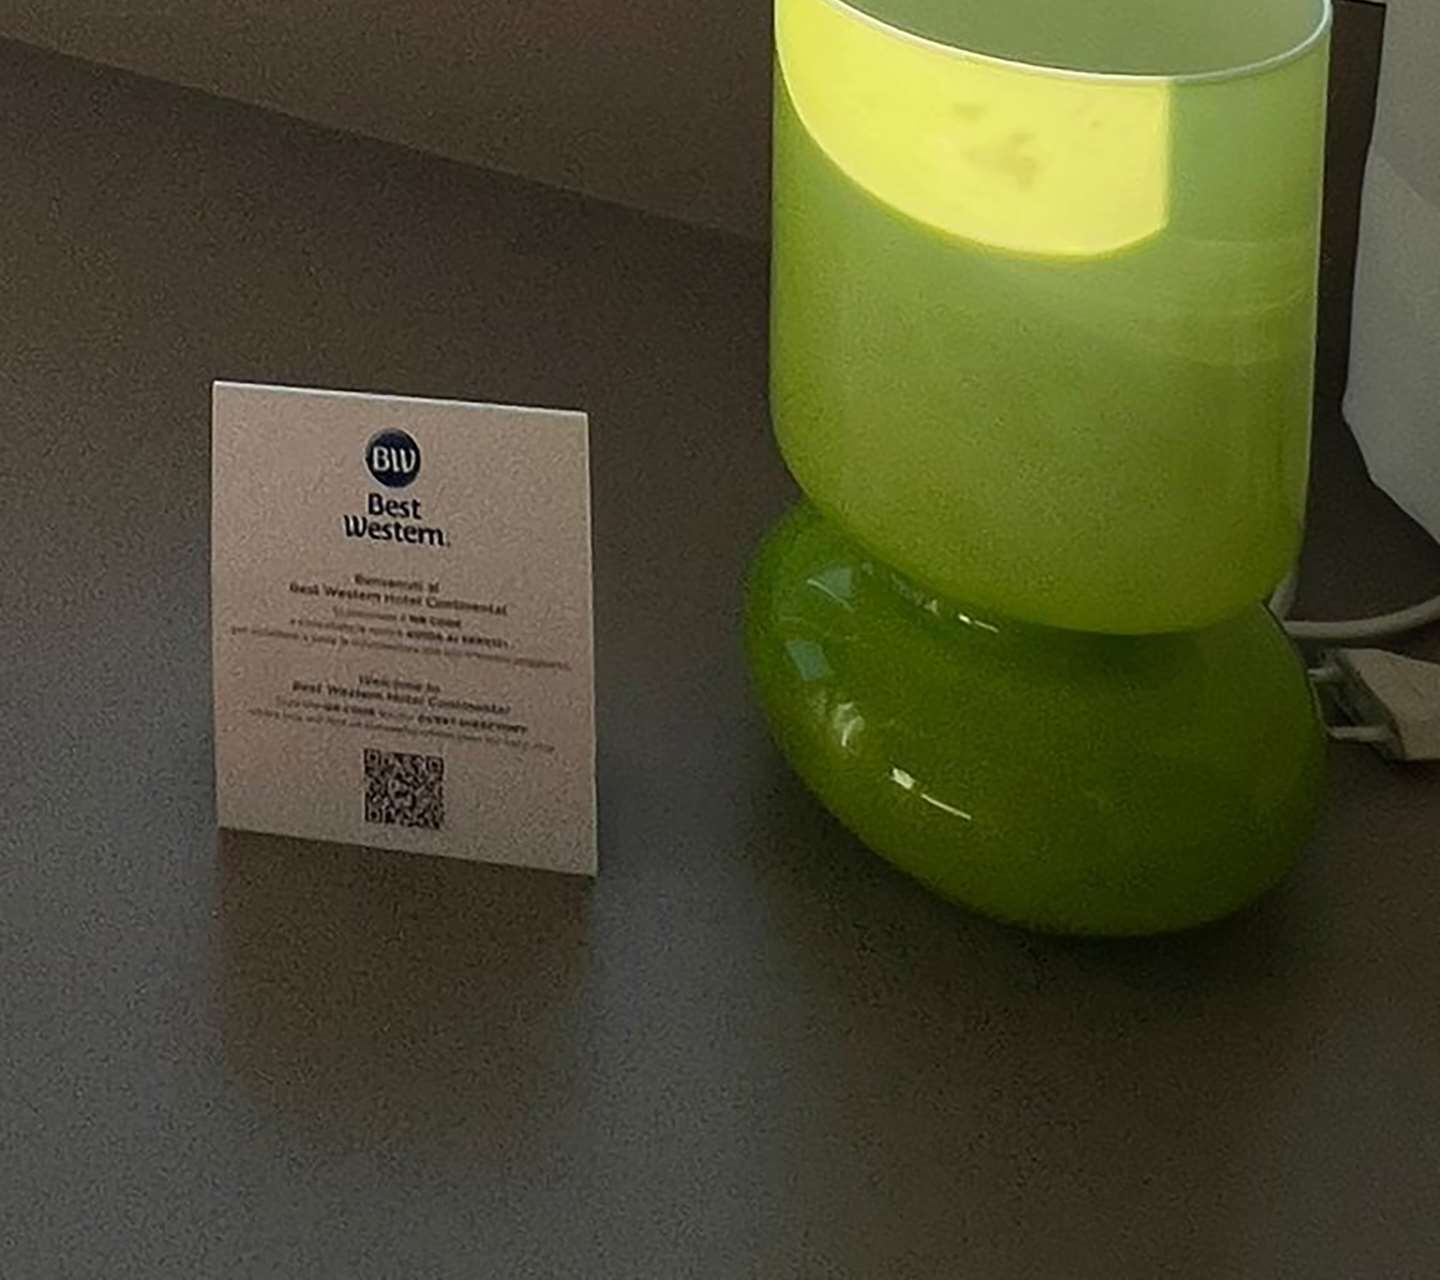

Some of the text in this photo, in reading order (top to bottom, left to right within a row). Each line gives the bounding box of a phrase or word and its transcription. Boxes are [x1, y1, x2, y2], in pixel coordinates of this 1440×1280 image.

[373, 446, 416, 474] BW
[368, 492, 422, 520] Best
[343, 515, 445, 547] Western
